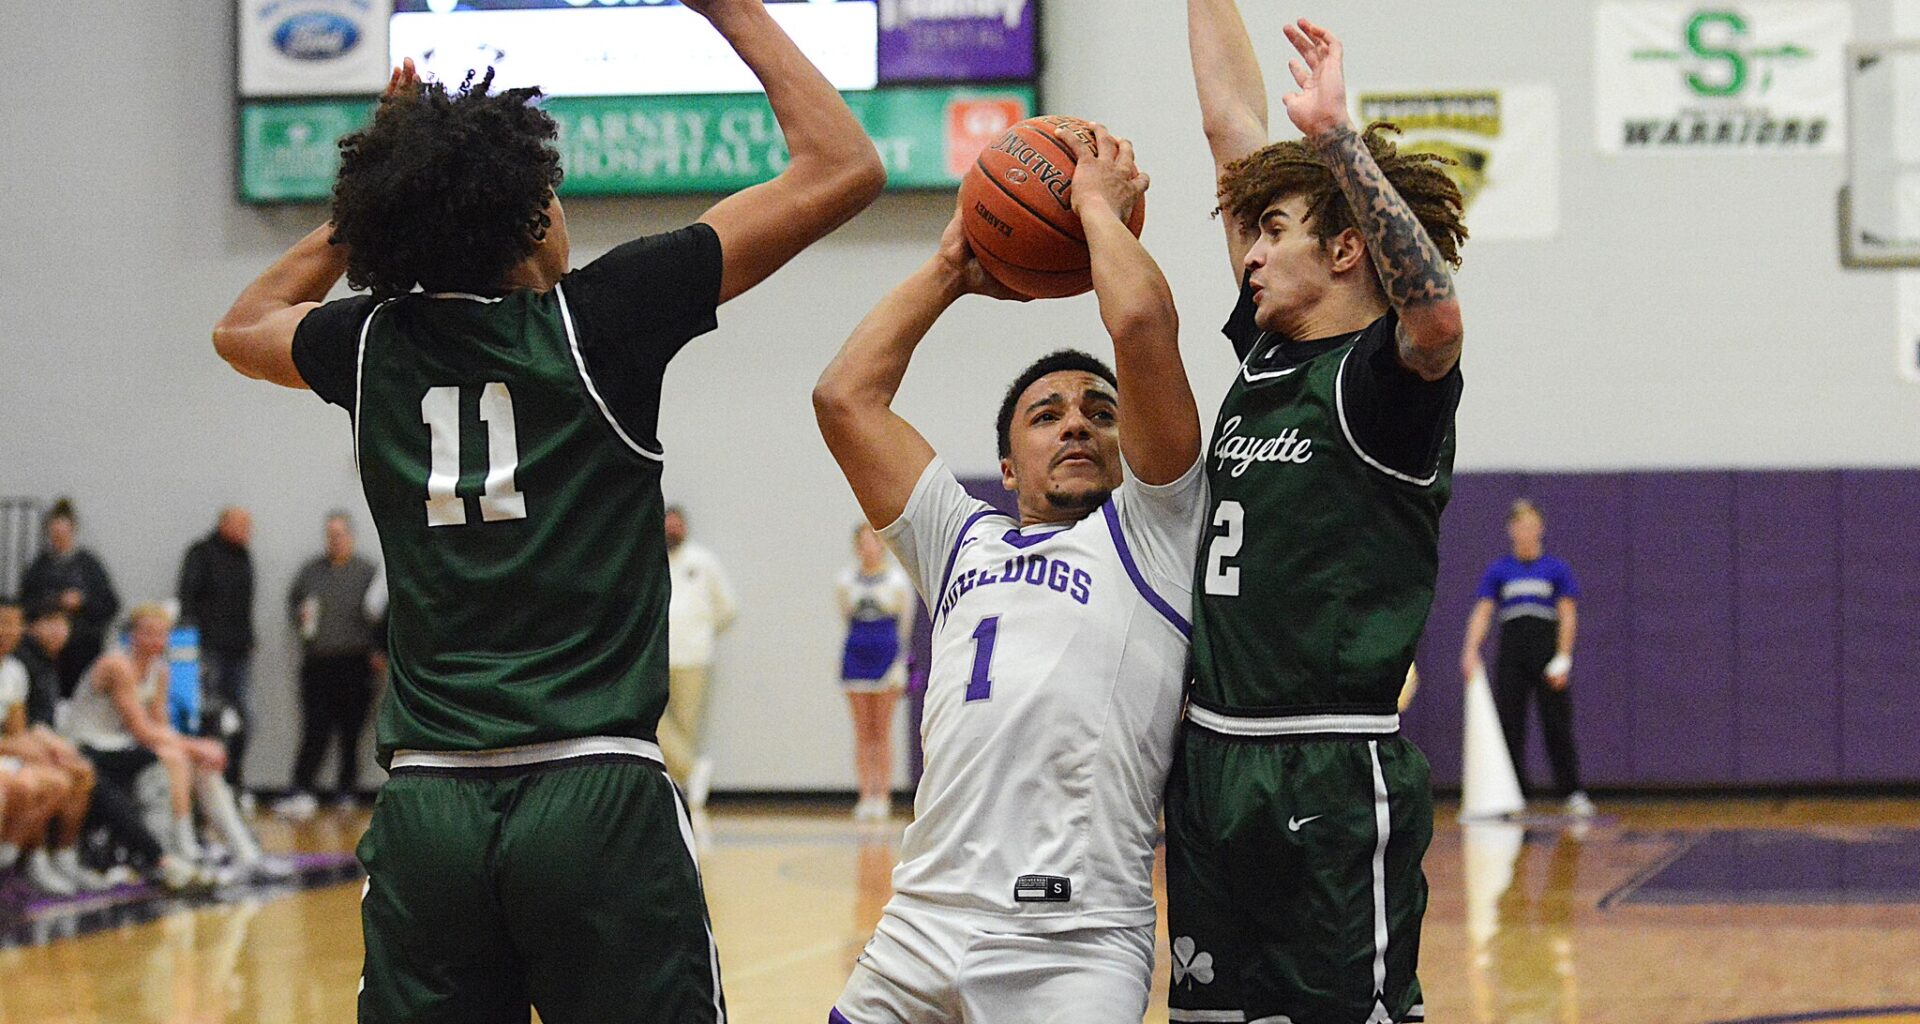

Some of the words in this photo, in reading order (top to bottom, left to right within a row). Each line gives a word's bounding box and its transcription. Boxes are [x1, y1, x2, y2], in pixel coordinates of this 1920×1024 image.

[1624, 117, 1828, 146] WARRIORS
[421, 382, 527, 527] 11
[1204, 500, 1245, 596] 2
[963, 613, 1003, 706] 1
[1053, 883, 1062, 893] S
